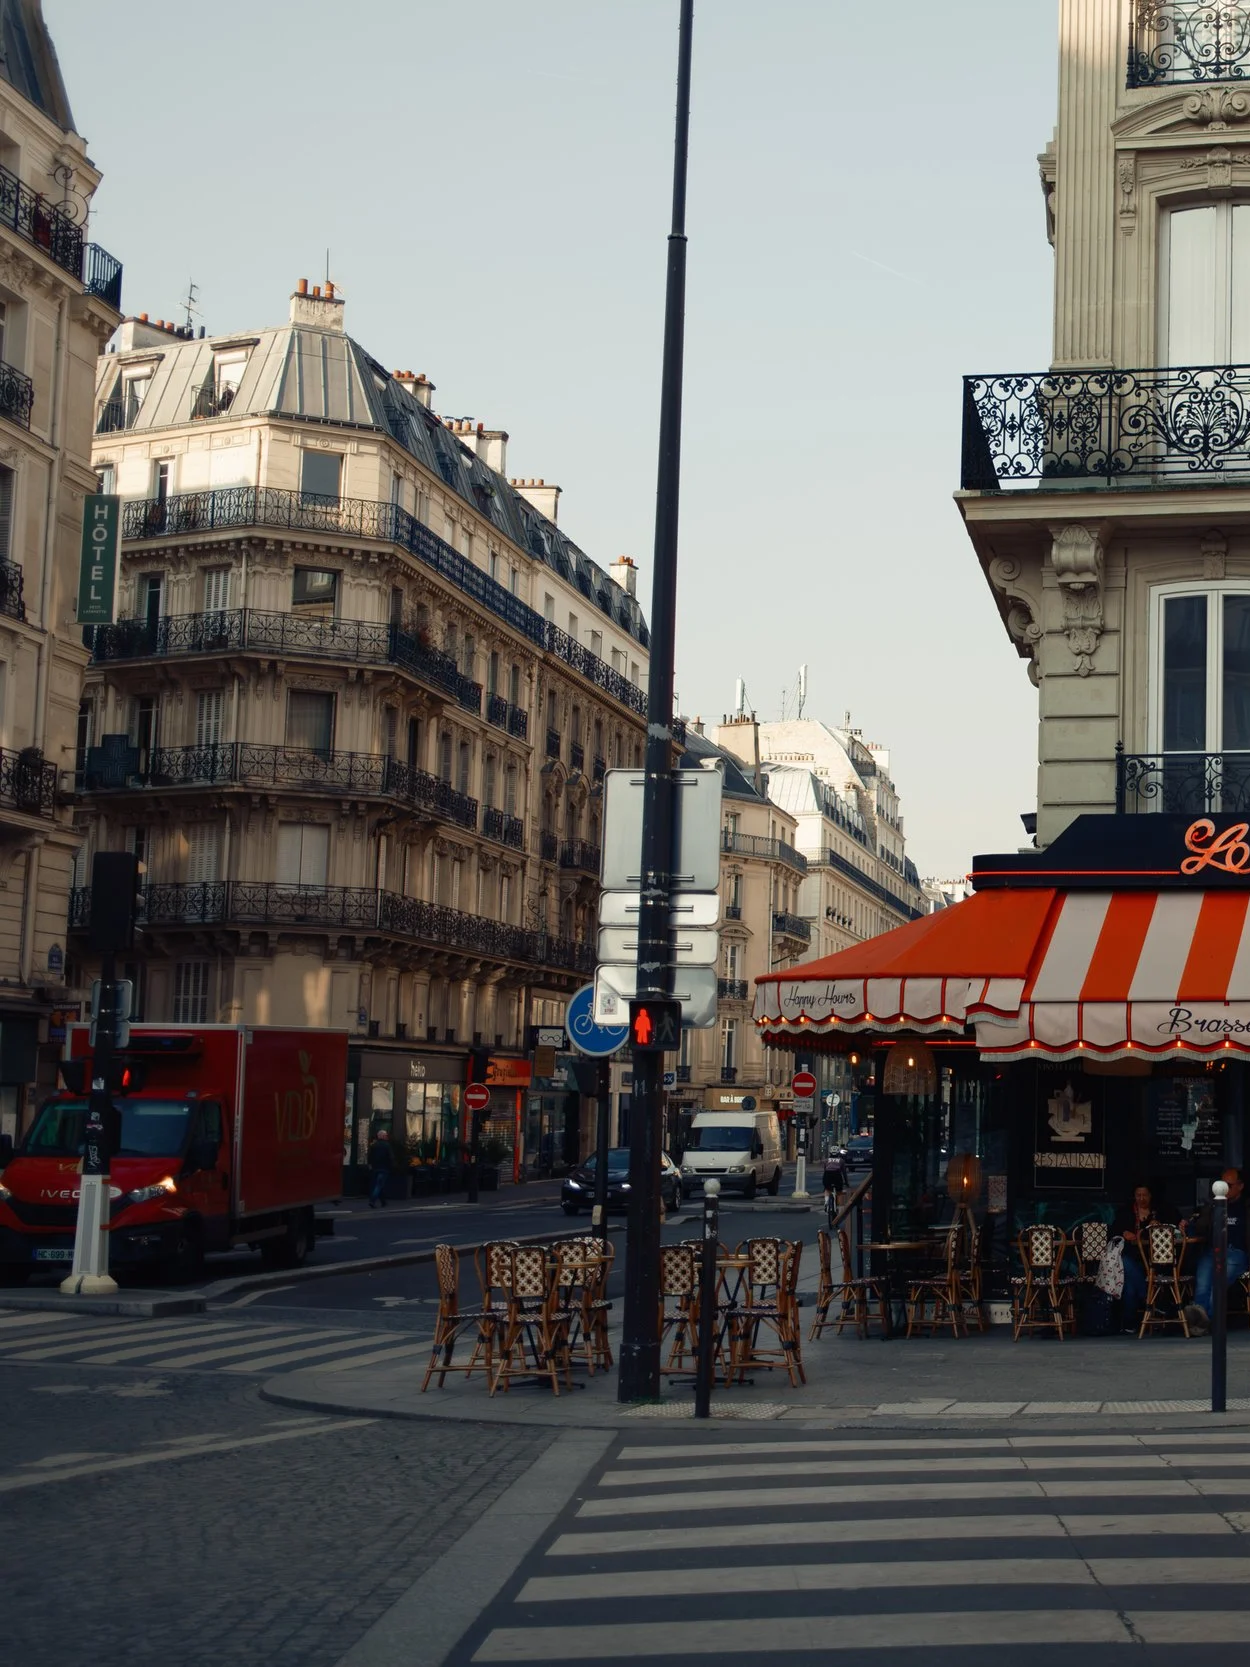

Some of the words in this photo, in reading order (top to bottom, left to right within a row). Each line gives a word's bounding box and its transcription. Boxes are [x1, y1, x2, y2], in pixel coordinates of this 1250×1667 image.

[784, 985, 816, 1008] Happy
[818, 985, 856, 1005] Hours
[1033, 1153, 1107, 1168] RESTAURANT
[40, 1189, 81, 1198] IVEC
